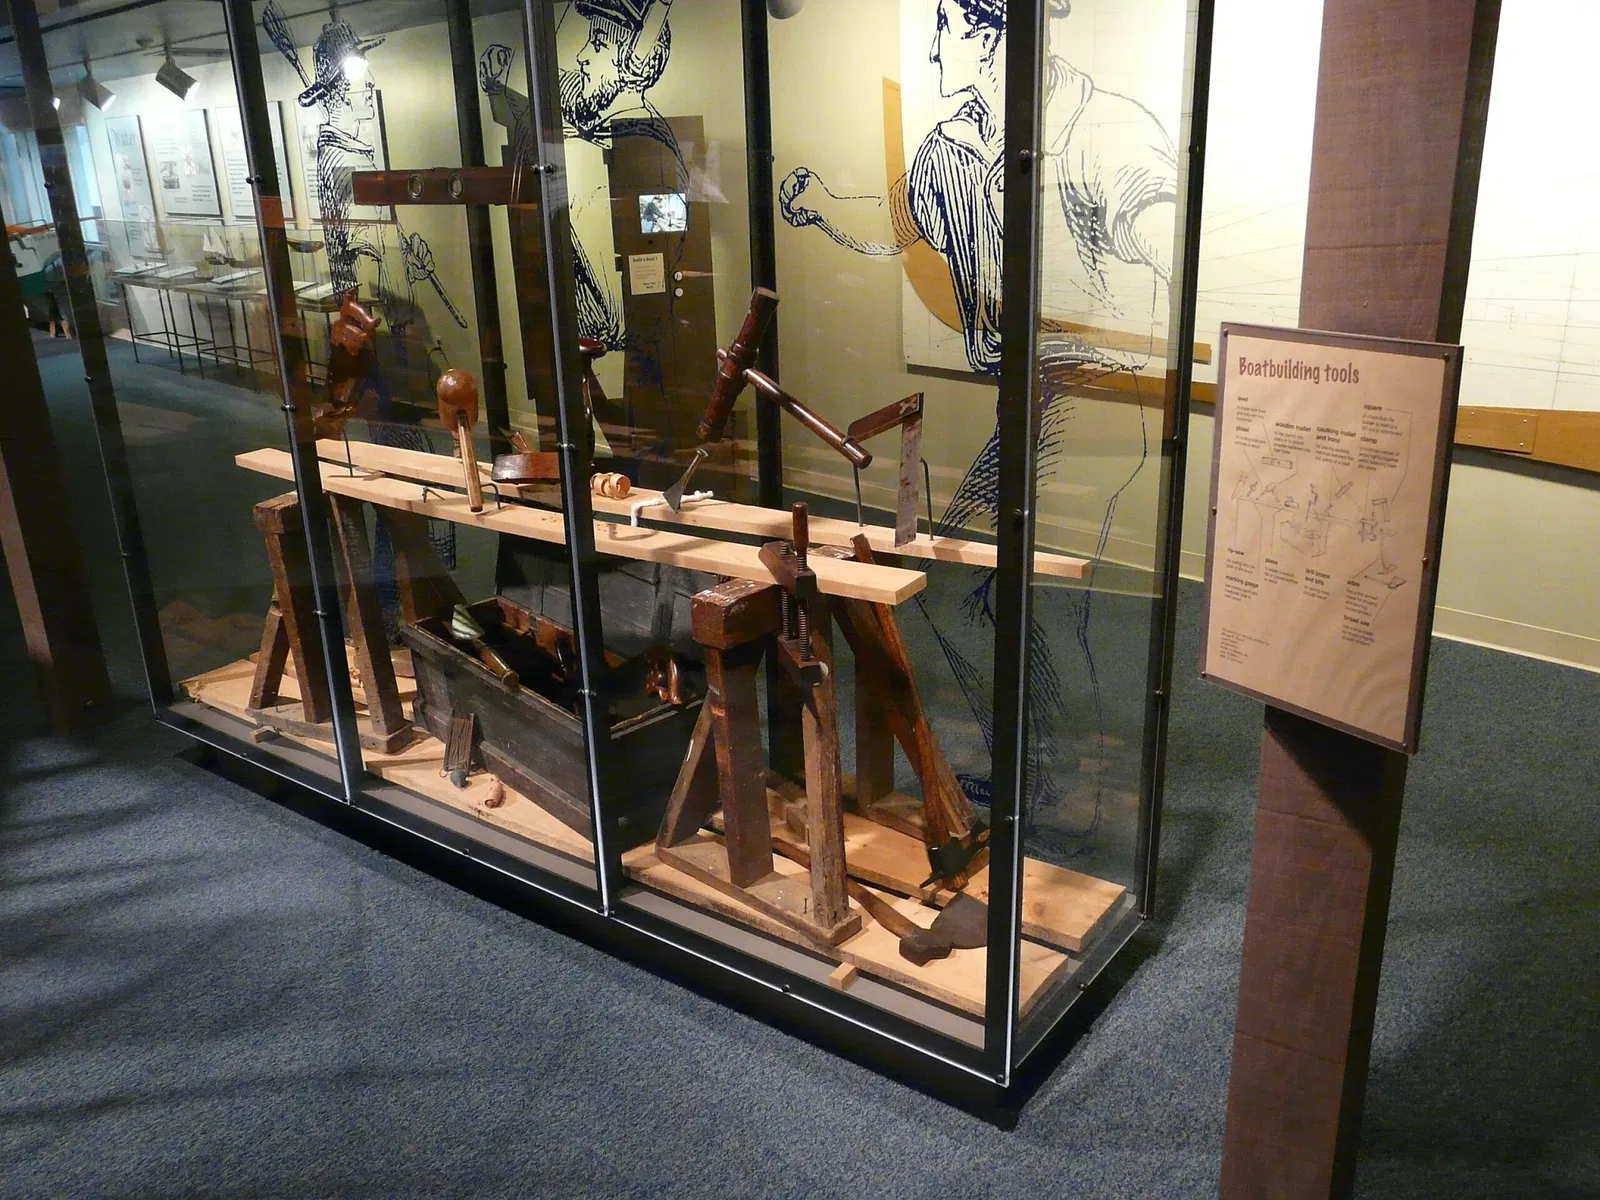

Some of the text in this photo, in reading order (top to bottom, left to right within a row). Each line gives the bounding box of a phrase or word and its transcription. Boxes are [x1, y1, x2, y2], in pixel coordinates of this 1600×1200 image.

[1239, 356, 1360, 384] Boatbuilding tools
[1275, 422, 1295, 430] wooden
[1316, 426, 1339, 436] caulking
